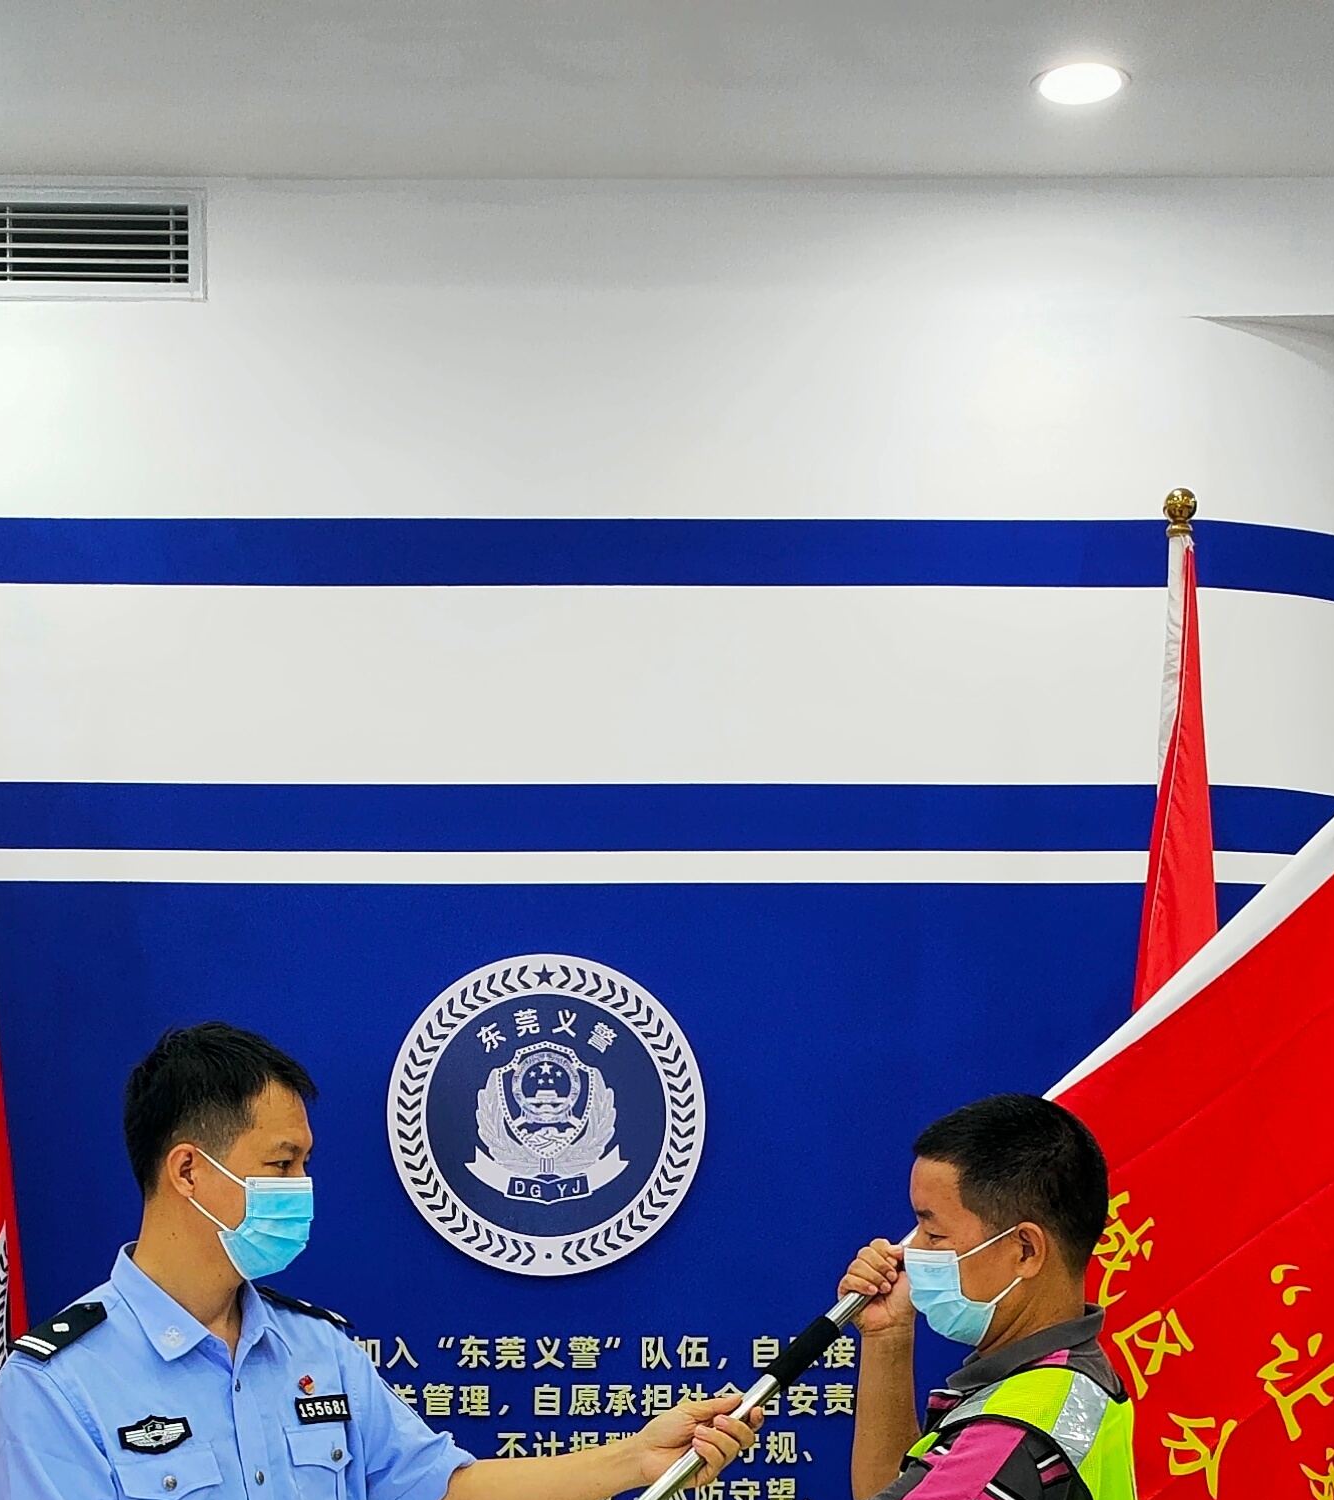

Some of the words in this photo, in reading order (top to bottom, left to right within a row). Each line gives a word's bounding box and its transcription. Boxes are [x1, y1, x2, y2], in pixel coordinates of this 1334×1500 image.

[476, 1008, 618, 1053] 东莞义警
[298, 1401, 349, 1419] 155681
